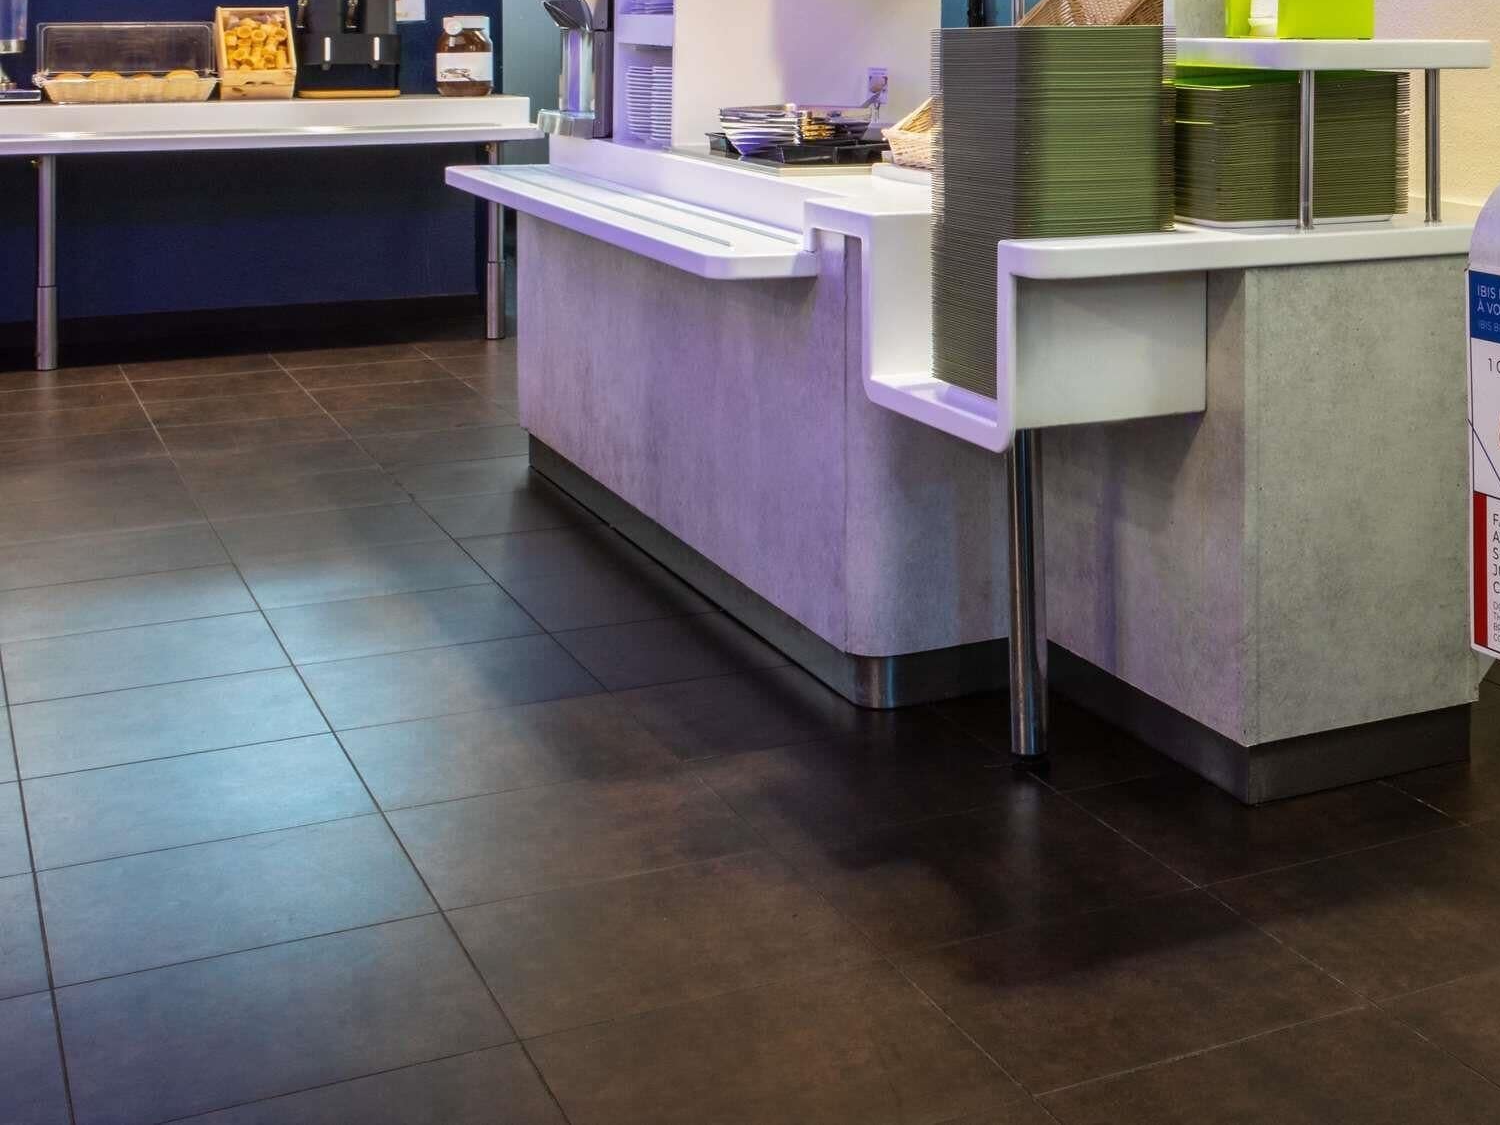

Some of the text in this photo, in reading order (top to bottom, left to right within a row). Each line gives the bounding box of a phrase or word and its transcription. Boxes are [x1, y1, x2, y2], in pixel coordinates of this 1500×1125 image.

[1477, 285, 1496, 300] IBIS
[1476, 299, 1485, 313] À
[1479, 319, 1493, 332] IBIS
[1488, 357, 1493, 372] 1
